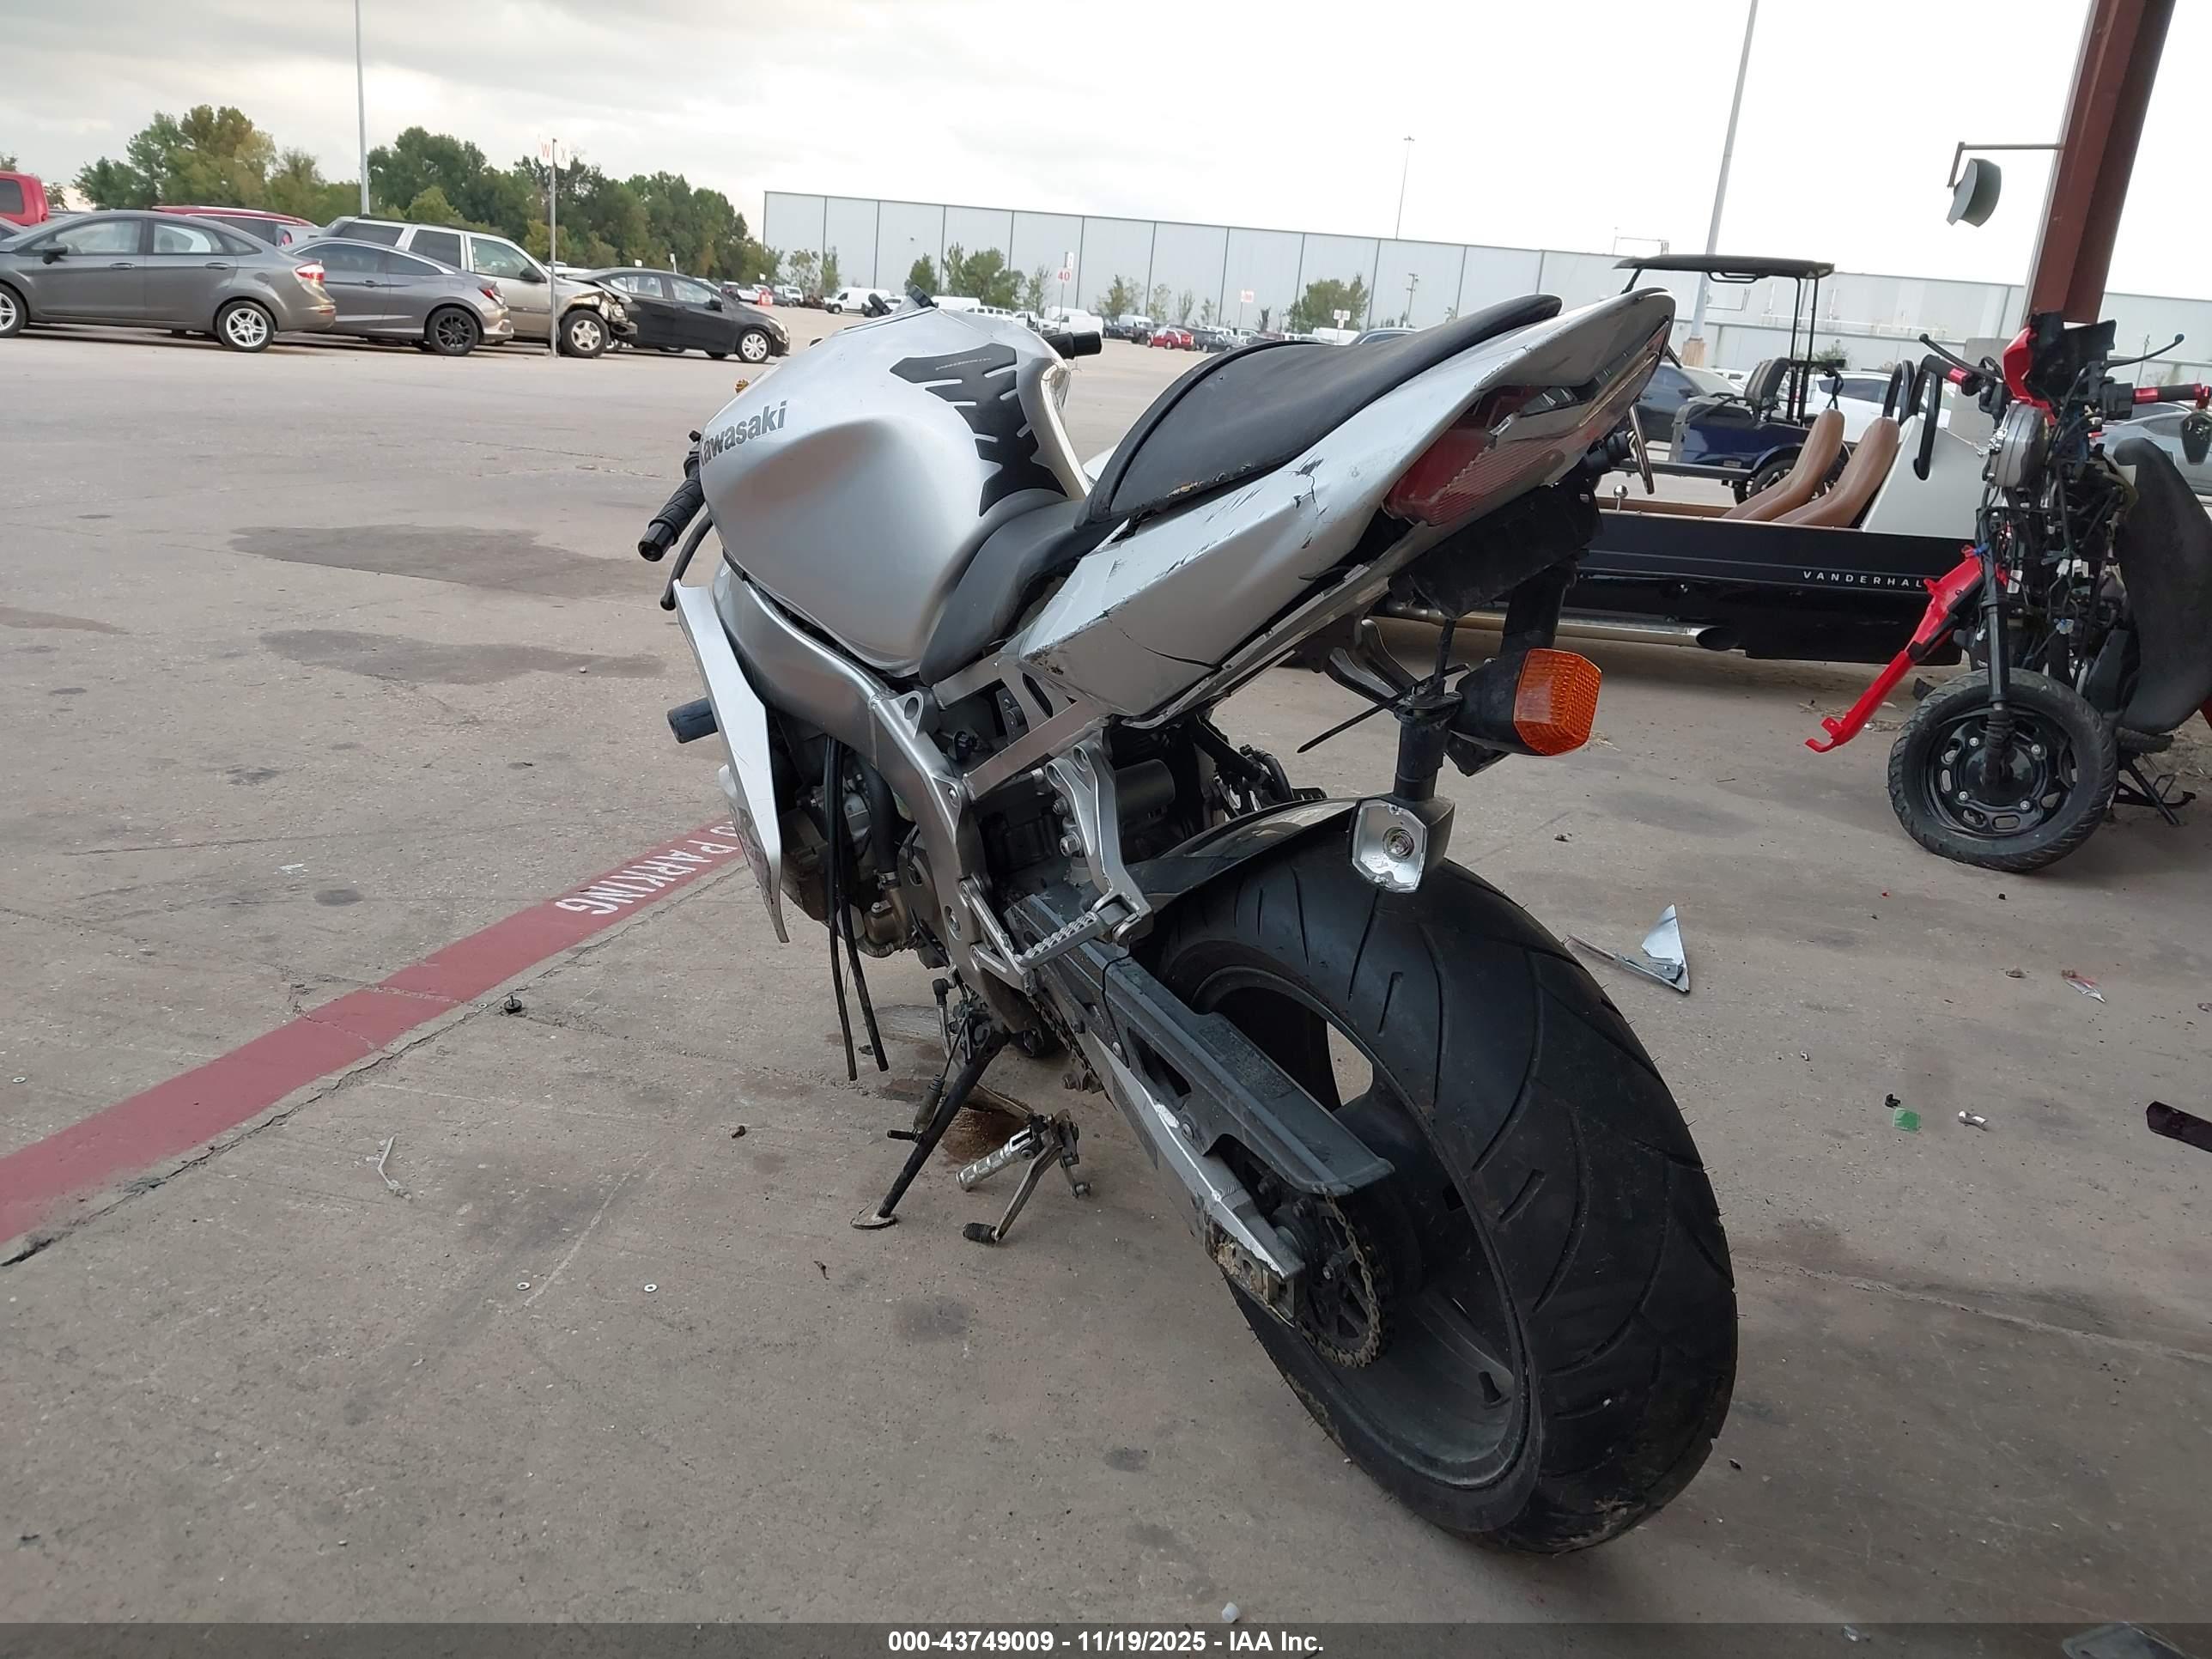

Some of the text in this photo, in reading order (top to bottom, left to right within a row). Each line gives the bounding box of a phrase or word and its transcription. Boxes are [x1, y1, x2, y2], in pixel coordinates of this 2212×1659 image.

[1058, 270, 1071, 282] 40
[1803, 570, 1923, 588] VANDERHAL
[555, 839, 738, 915] PARKING
